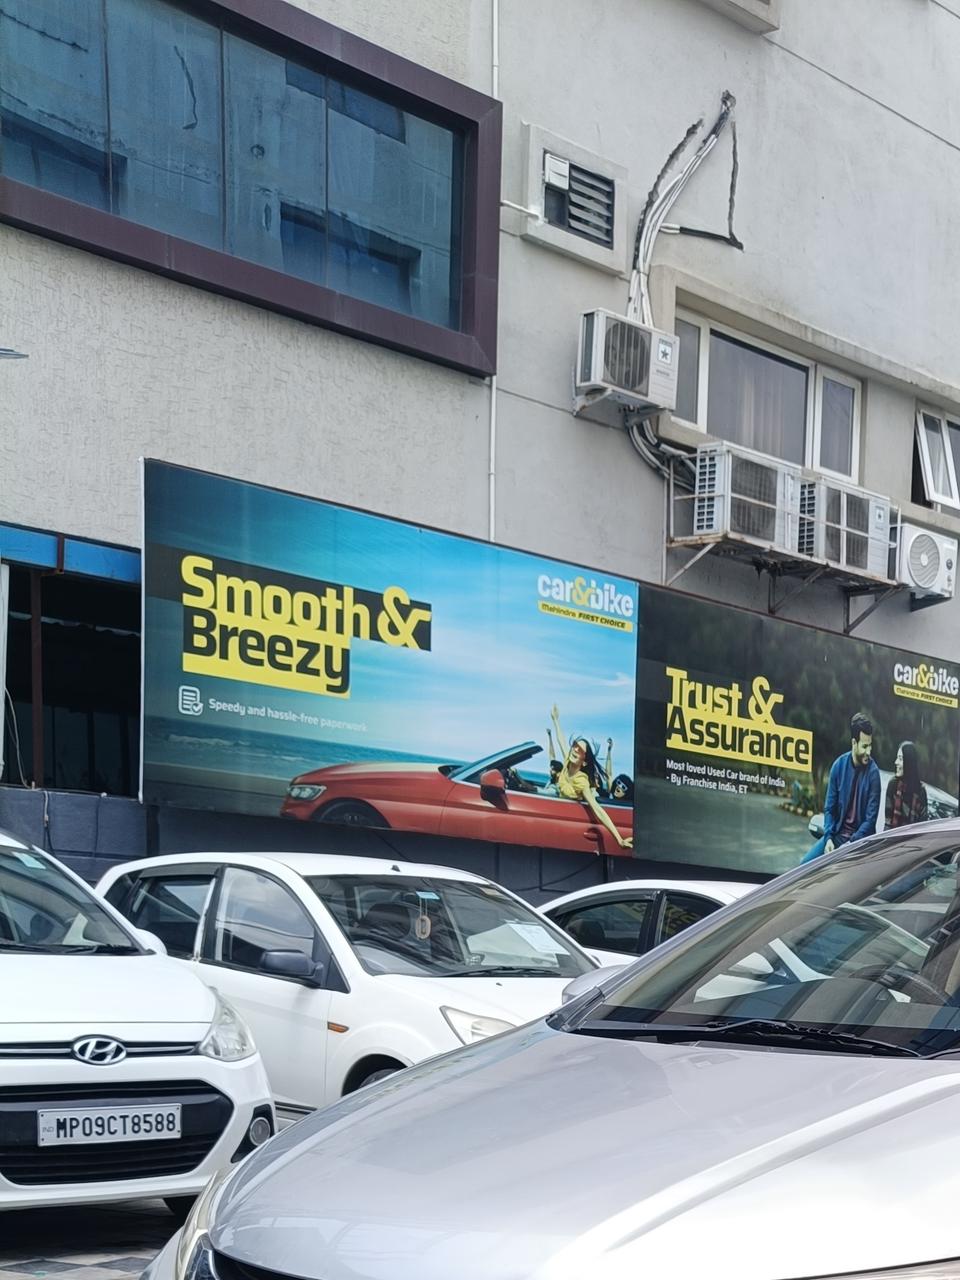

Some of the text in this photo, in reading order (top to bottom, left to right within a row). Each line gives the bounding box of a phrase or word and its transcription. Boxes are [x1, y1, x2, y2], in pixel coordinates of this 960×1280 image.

[181, 555, 432, 649] Smooth &
[537, 574, 633, 617] car&bike
[578, 611, 600, 623] FIRST
[600, 616, 626, 629] CHOICE
[183, 605, 350, 693] Breezy
[666, 666, 784, 725] Trust &
[894, 663, 959, 695] car&bike
[208, 698, 368, 732] Speedy and hassle-free paperwork
[666, 706, 810, 765] Assurance
[666, 759, 785, 788] Most loved Used Car brand of India
[671, 773, 681, 786] By
[682, 775, 717, 790] Franchise
[718, 781, 738, 794] India,
[739, 784, 749, 795] ET
[56, 1112, 176, 1139] MP09CT8588
